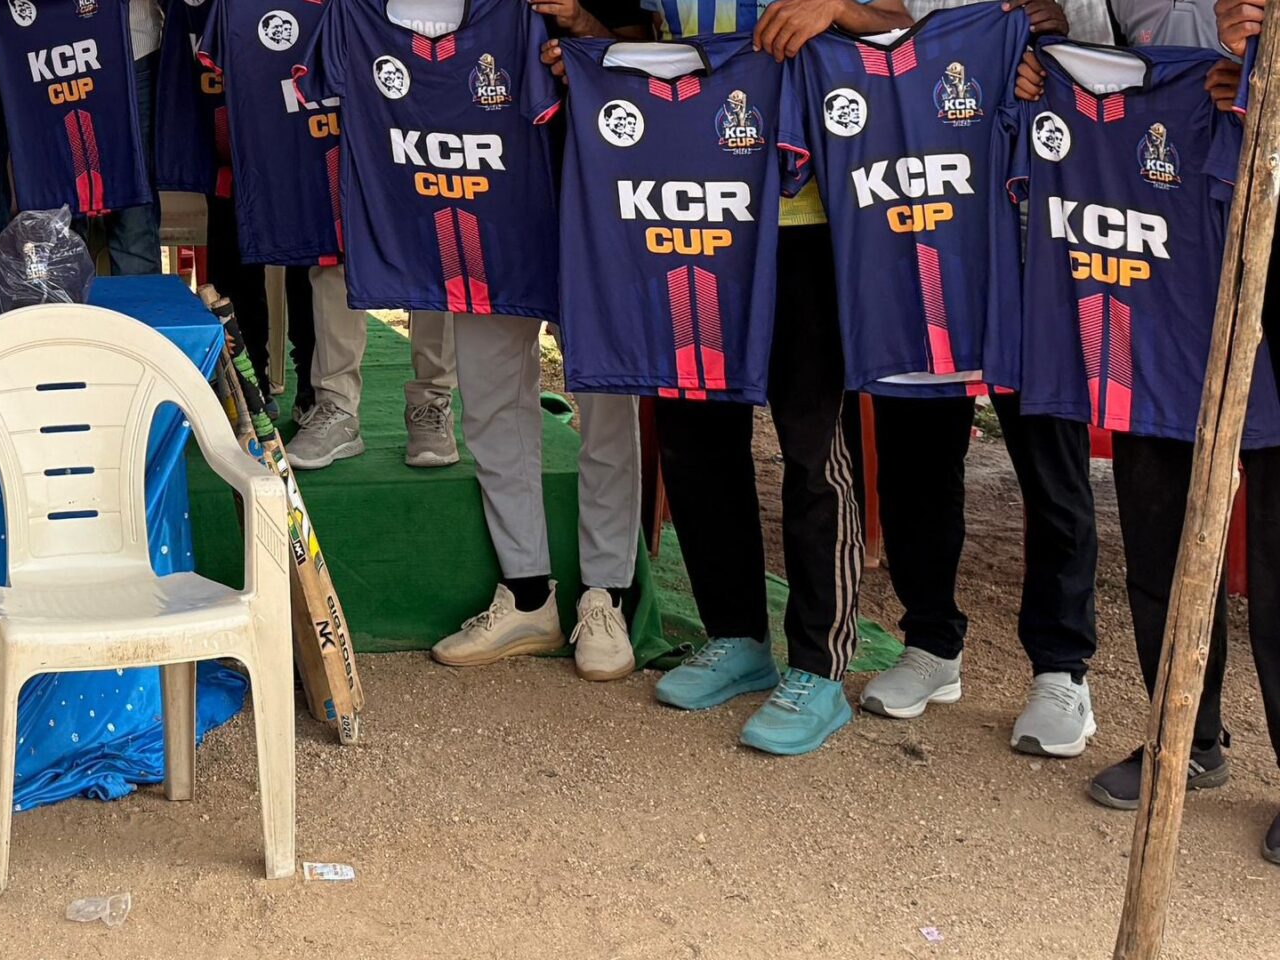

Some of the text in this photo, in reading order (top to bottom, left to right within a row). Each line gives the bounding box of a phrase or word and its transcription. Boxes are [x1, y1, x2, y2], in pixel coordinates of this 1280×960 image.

[27, 39, 102, 83] KCR
[48, 76, 94, 105] CUP
[477, 85, 508, 96] KCR
[480, 95, 505, 104] CUP
[944, 98, 977, 110] KCR
[947, 109, 975, 119] CUP
[725, 126, 758, 138] KCR
[727, 137, 755, 148] CUP
[389, 128, 506, 171] KCR
[851, 153, 976, 209] KCR
[1146, 159, 1175, 175] KCR
[1148, 170, 1173, 182] CUP
[414, 172, 490, 200] CUP
[617, 180, 756, 222] KCR
[645, 226, 733, 257] CUP
[1048, 196, 1171, 259] KCR
[1068, 250, 1151, 287] CUP
[315, 621, 336, 651] NK
